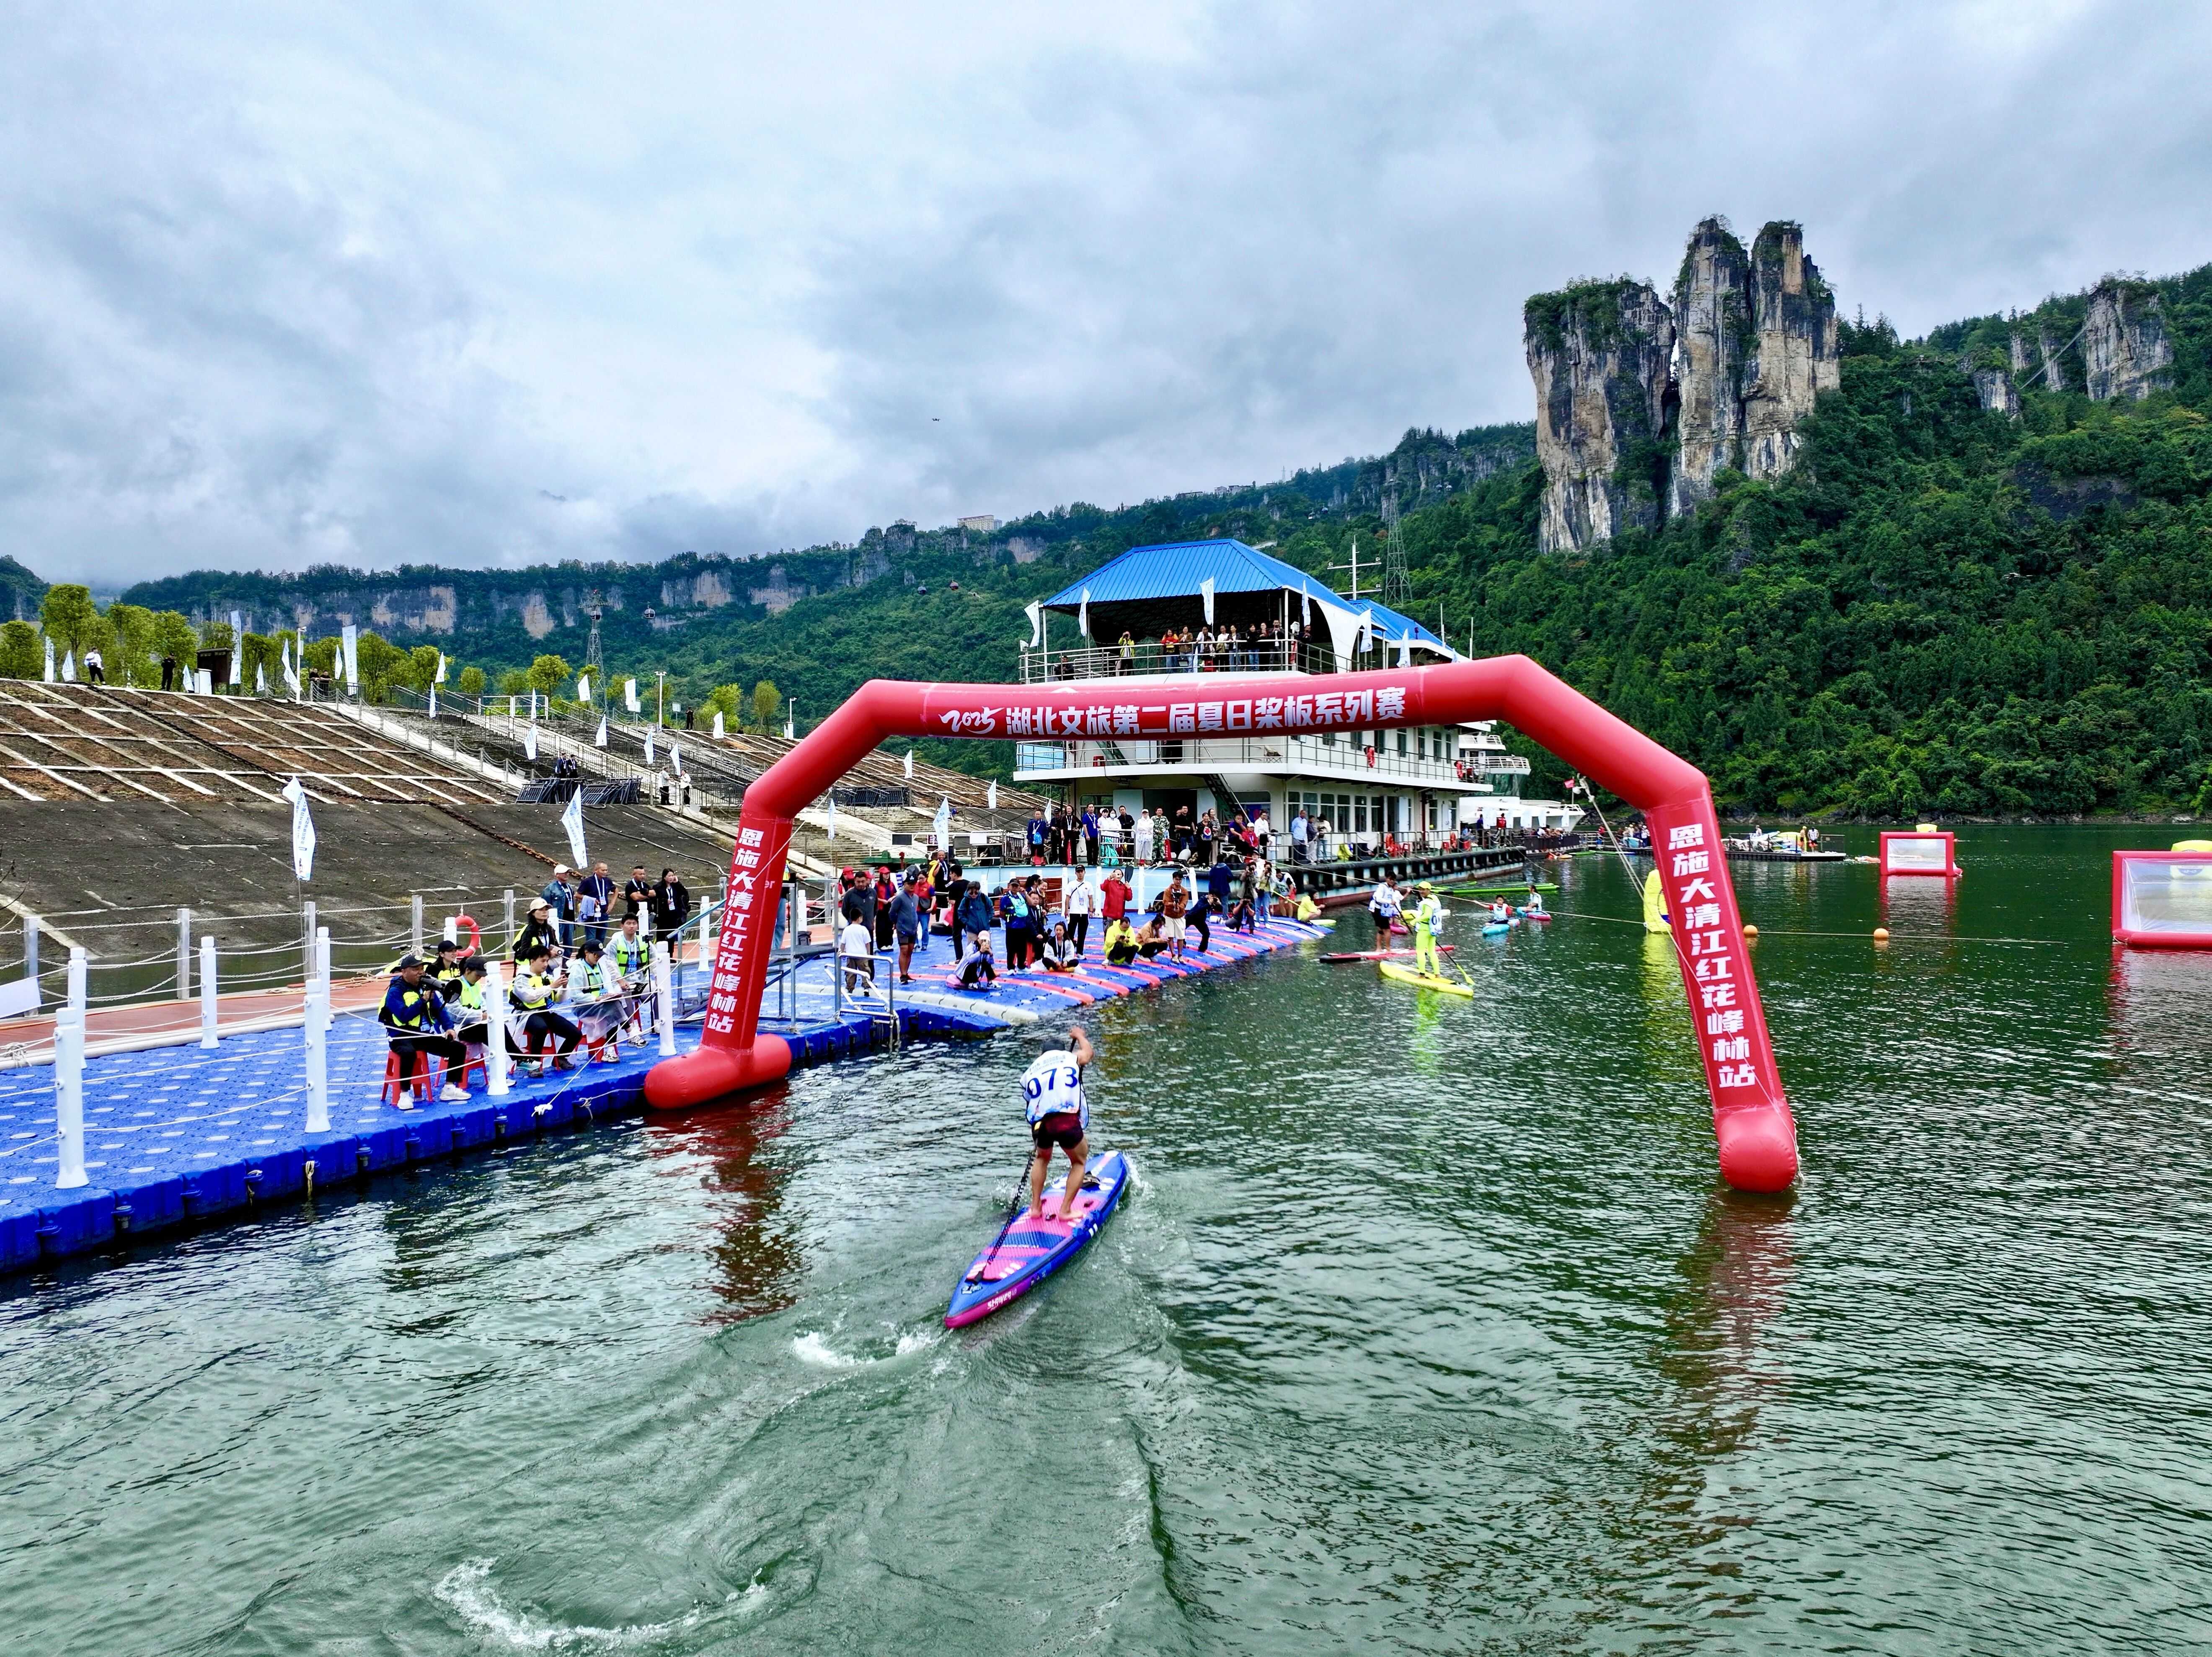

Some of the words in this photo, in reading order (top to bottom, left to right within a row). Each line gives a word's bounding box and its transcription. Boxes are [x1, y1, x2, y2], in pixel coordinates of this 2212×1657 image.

[938, 706, 1003, 735] 2025
[1005, 687, 1406, 736] 湖北文旅第二届夏日桨板系列赛
[707, 827, 763, 1033] 恩施大清江红花峰林站
[1668, 823, 1756, 1088] 恩施大清江红花峰林站
[1027, 1066, 1078, 1099] 073
